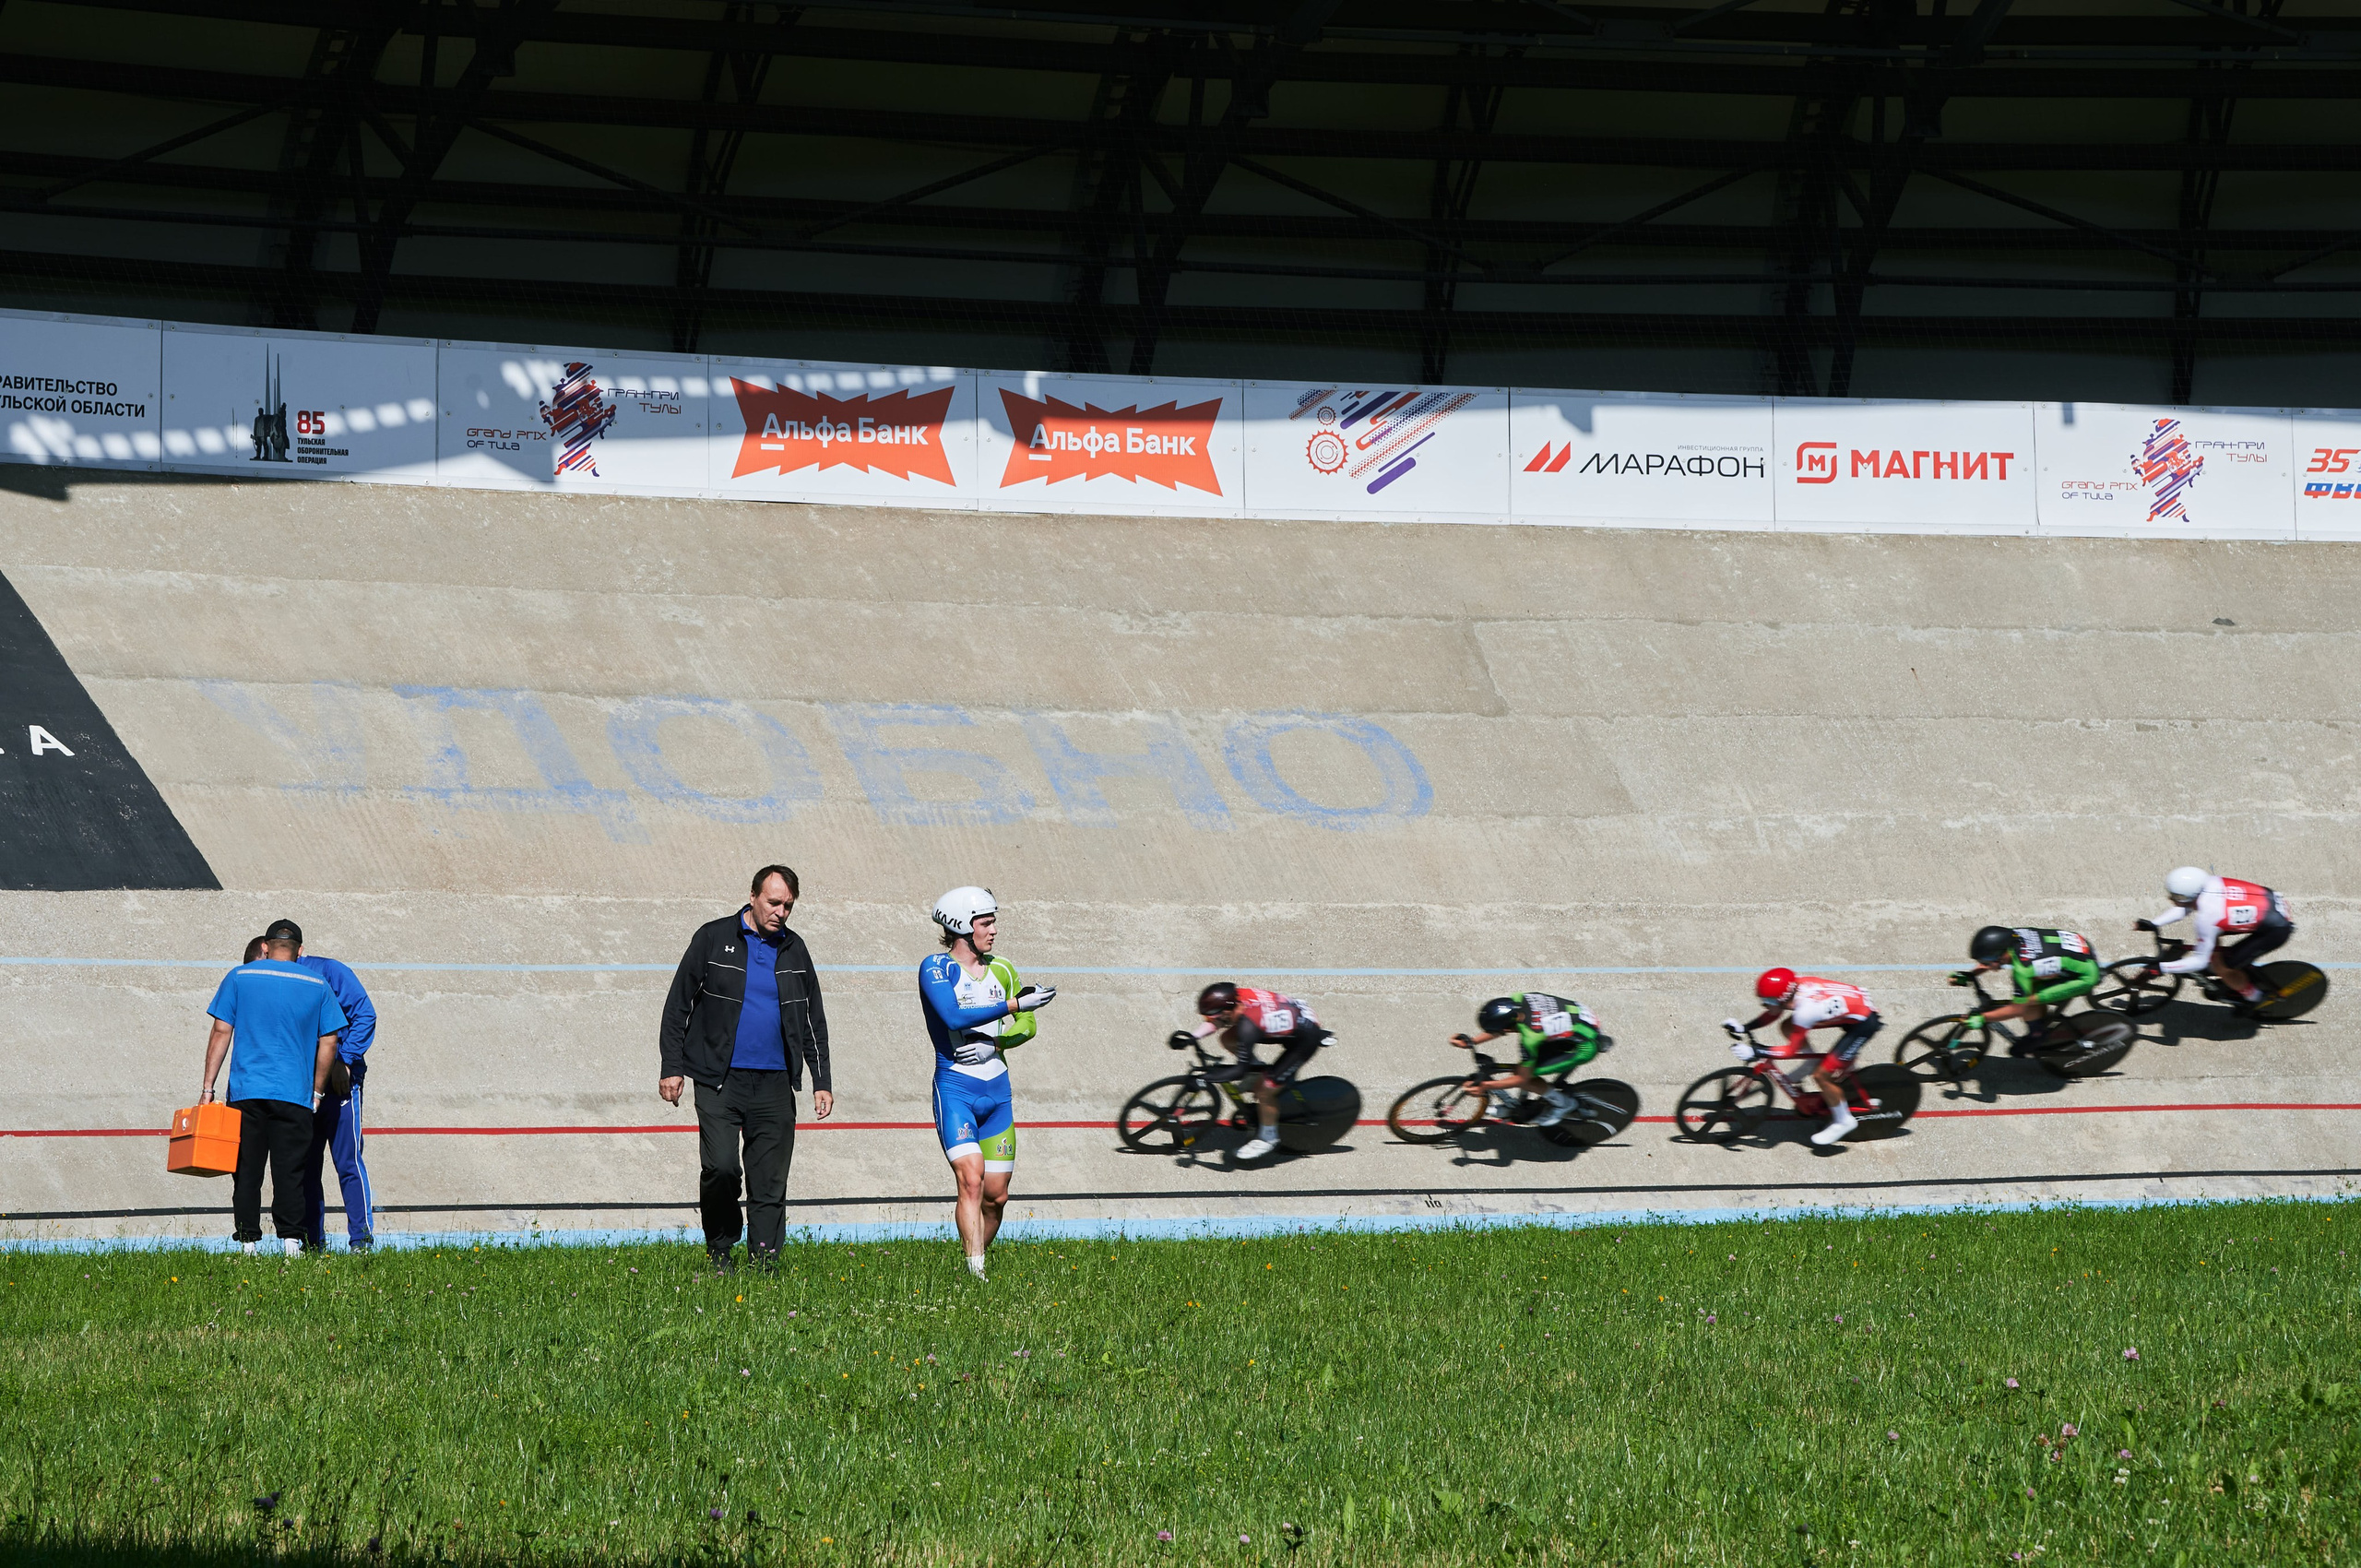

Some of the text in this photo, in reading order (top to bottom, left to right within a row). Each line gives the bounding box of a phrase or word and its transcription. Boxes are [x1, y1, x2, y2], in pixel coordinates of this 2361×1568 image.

[0, 374, 118, 397] АВИТЕЛЬСТВО
[608, 387, 679, 400] ГРАН-ПРИ
[0, 395, 146, 418] ЛЬСКОЙ ОБЛАСТИ
[638, 402, 682, 415] ТУЛЫ
[297, 410, 326, 435] 85
[761, 412, 929, 451] Альфа Банк
[297, 437, 326, 446] ТУЛЬСКАЯ
[297, 446, 350, 457] ОБОРОНИТЕЛЬНАЯ
[1028, 423, 1197, 461] Альфа Банк
[2195, 441, 2265, 450] ГРАН-ПРИ
[297, 456, 327, 466] ОПЕРАЦИЯ
[1579, 453, 1765, 479] МАРАФОН
[1851, 449, 2014, 481] МАГНИТ
[2225, 453, 2268, 463] ТУЛЫ
[2307, 448, 2361, 473] 35
[935, 909, 963, 930] KASK
